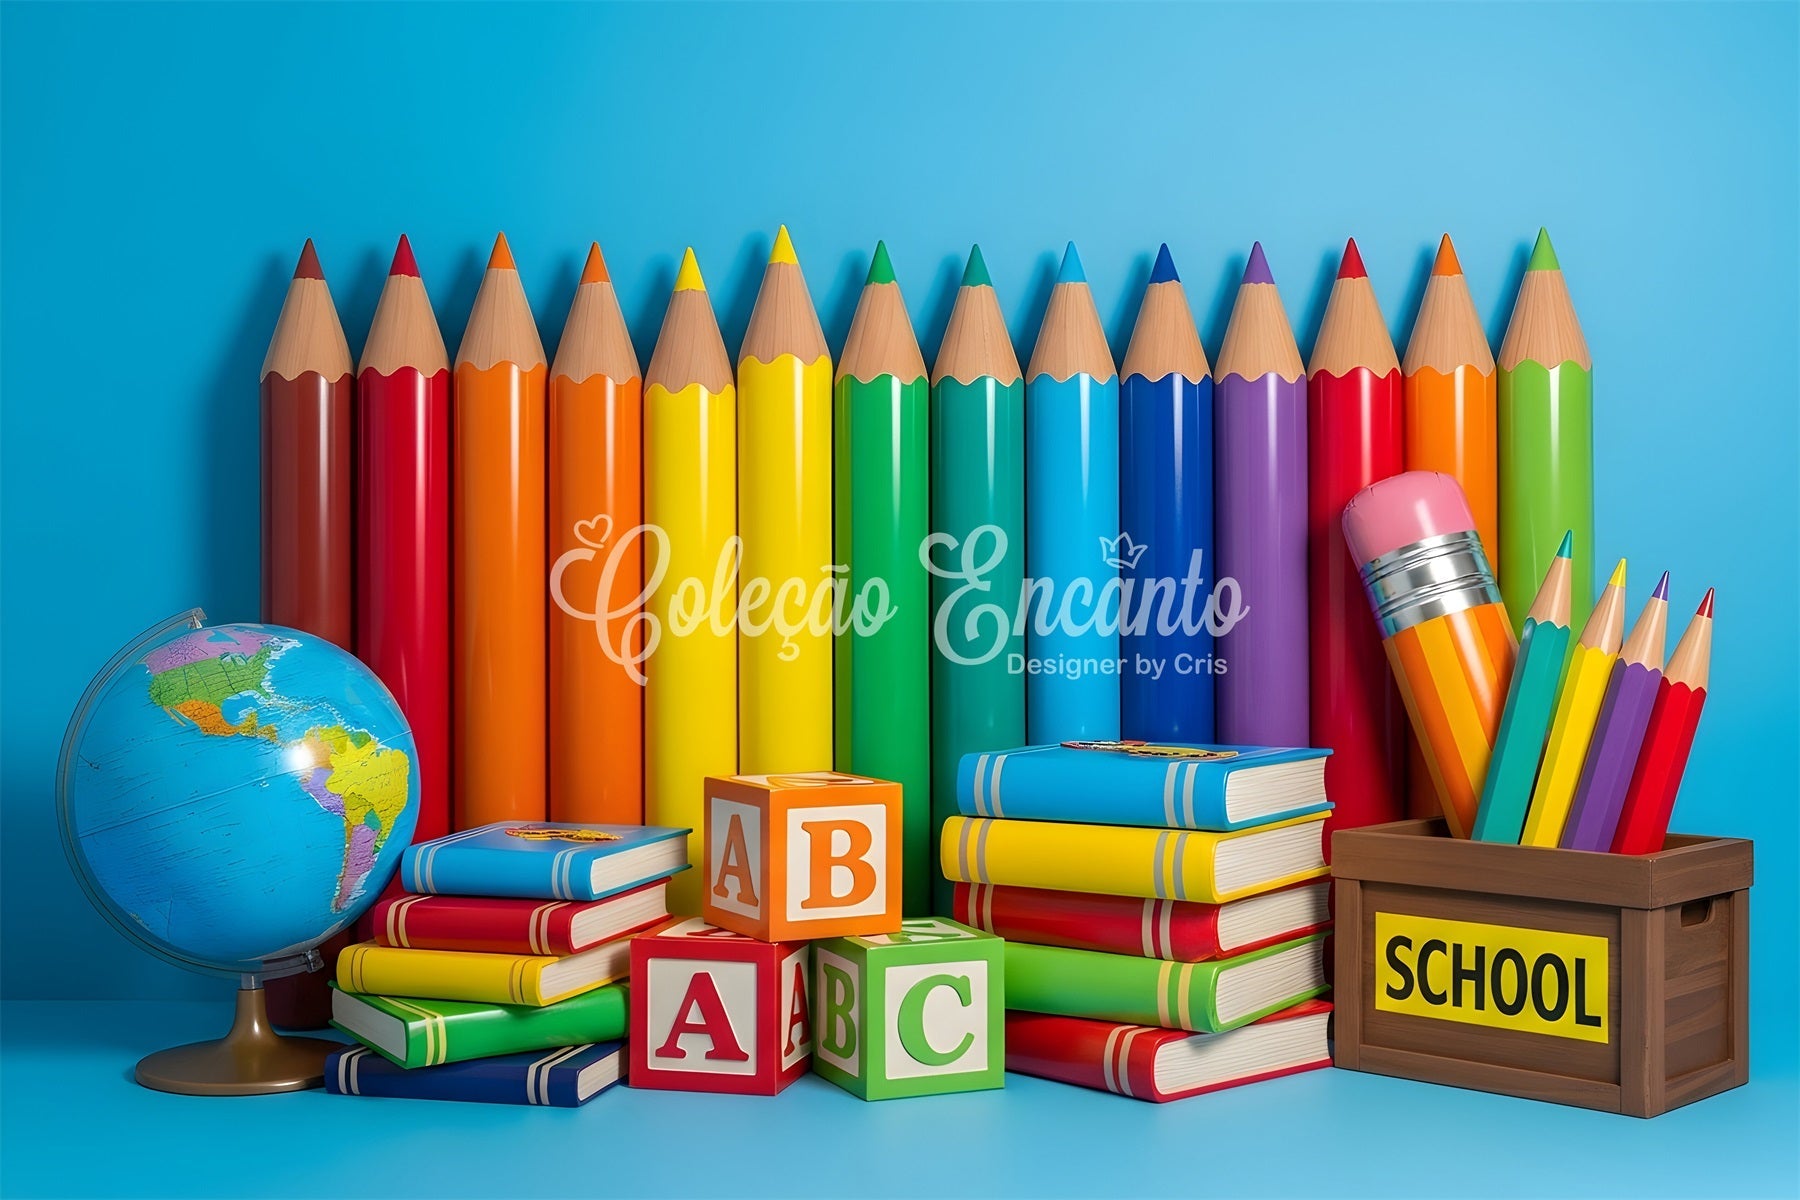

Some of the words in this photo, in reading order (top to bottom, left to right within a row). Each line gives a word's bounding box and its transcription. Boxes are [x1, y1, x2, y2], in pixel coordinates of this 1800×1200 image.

[713, 814, 759, 908] A
[801, 819, 877, 910] B
[655, 971, 750, 1062] A
[784, 962, 811, 1057] A
[822, 963, 857, 1060] B
[897, 973, 976, 1067] C
[1385, 935, 1602, 1028] SCHOOL
